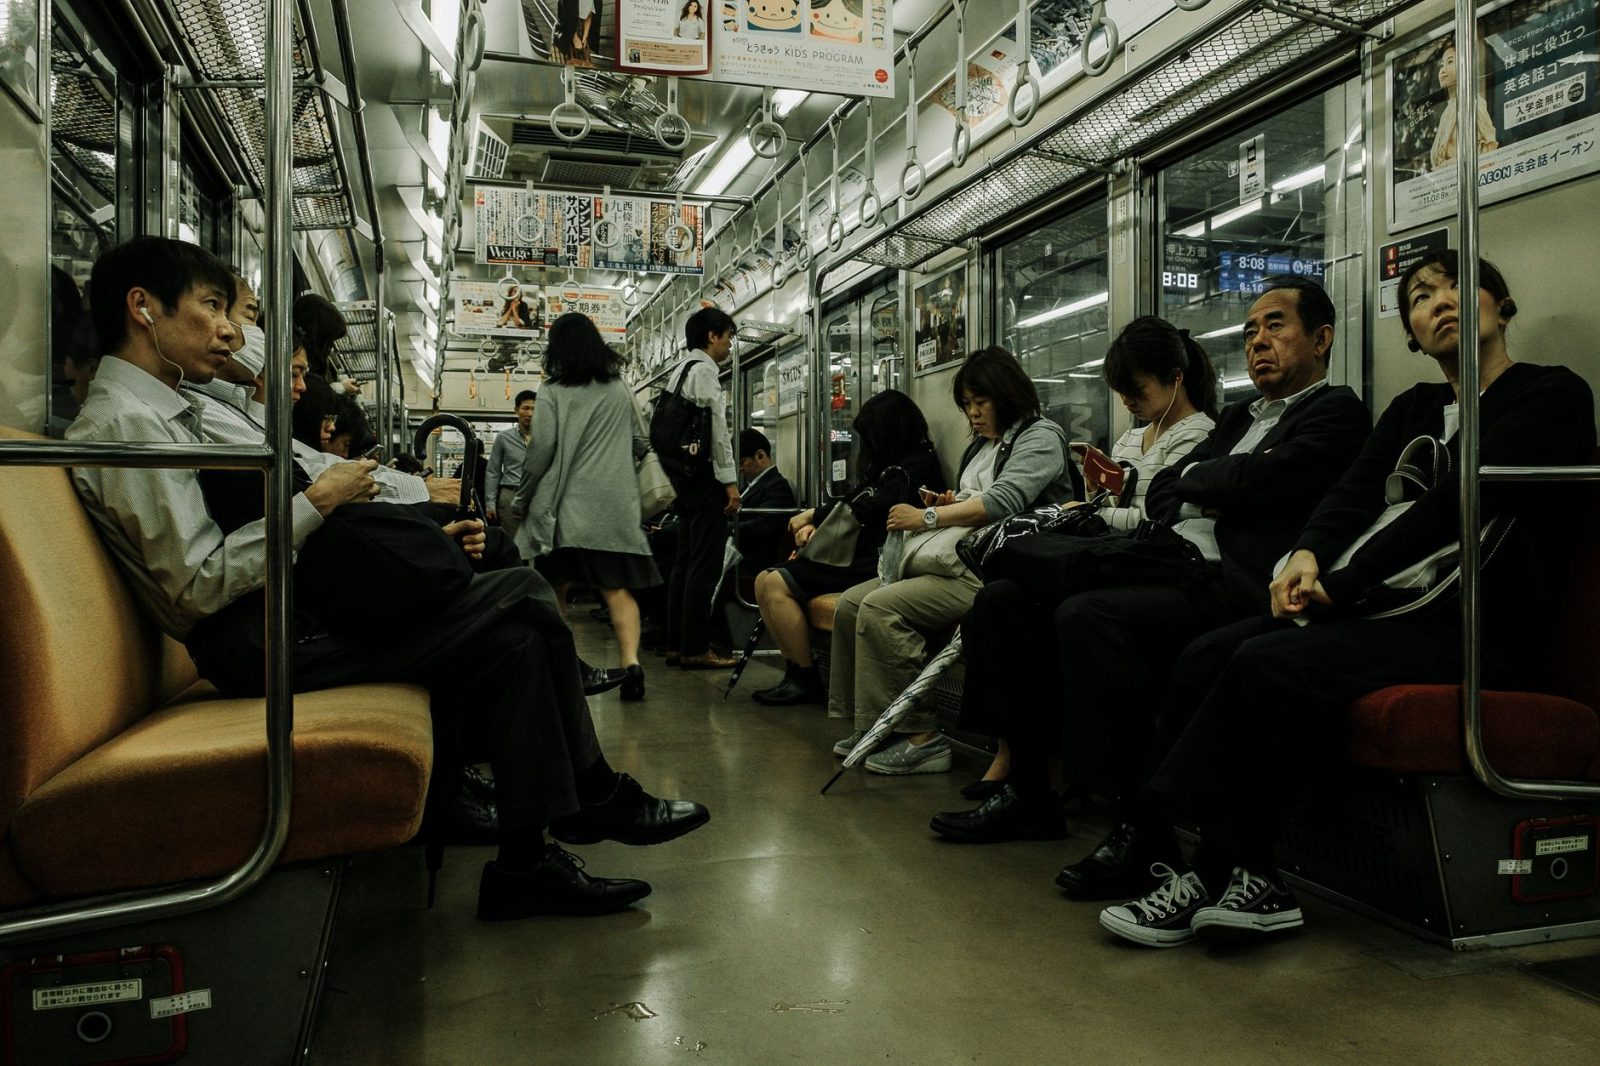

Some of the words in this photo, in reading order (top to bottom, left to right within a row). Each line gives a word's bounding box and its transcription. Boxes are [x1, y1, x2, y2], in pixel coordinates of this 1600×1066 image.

[747, 43, 780, 55] とうきゅう
[785, 49, 807, 59] KIDS
[813, 53, 864, 65] PROGRAM
[1504, 25, 1585, 70] 仕事に役立つ
[1504, 50, 1584, 95] 英会話コース
[1516, 90, 1564, 117] 入学金無料
[1478, 165, 1511, 187] AEON
[1514, 140, 1594, 176] 英会話イーオン
[566, 195, 578, 267] サバイバル時代
[579, 196, 591, 245] マンション
[489, 246, 530, 260] Wedge
[1166, 244, 1207, 258] 押上方面
[1239, 256, 1265, 270] 8:08
[1303, 262, 1323, 275] 押上
[1163, 272, 1197, 288] 8:08
[1240, 282, 1263, 293] 8:10
[567, 302, 601, 313] 定期券
